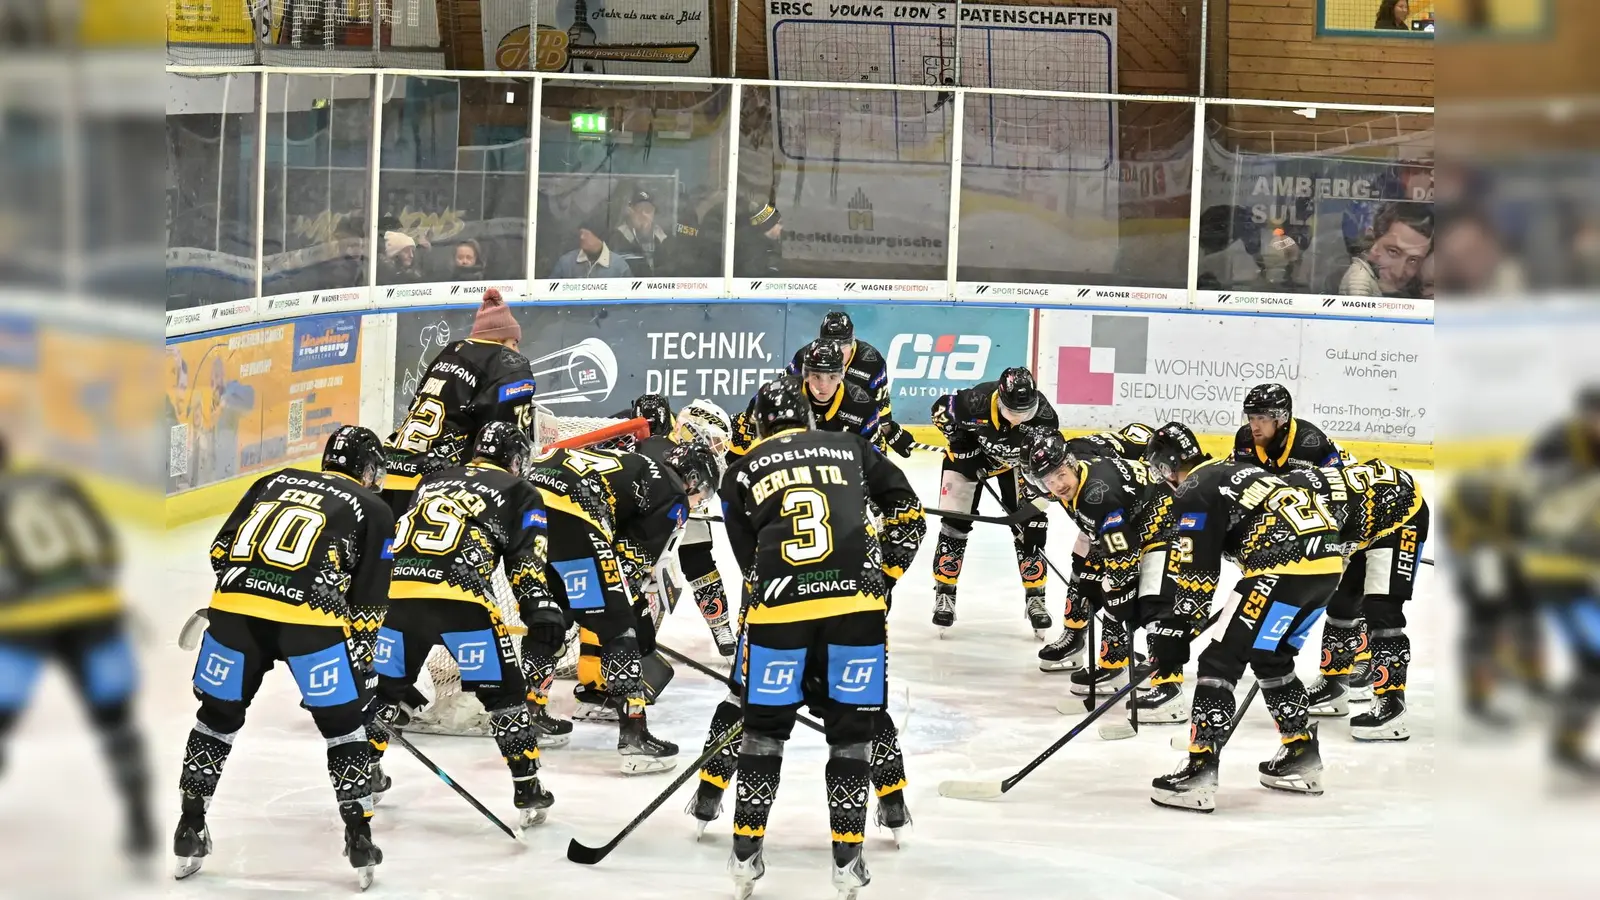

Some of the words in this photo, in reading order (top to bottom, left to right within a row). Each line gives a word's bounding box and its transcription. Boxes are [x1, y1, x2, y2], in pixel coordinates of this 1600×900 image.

[592, 9, 621, 20] Mehr
[624, 9, 637, 20] als
[676, 11, 701, 25] Bild
[771, 2, 813, 16] ERSC
[829, 5, 884, 18] YOUNG
[960, 8, 1113, 26] PATENSCHAFTEN
[571, 48, 689, 61] www.powerpublishing.de
[463, 286, 487, 294] WAGNER
[562, 283, 580, 291] SPORT
[581, 283, 608, 291] SIGNAGE
[676, 282, 708, 290] SPEDITION
[894, 284, 929, 292] SPEDITION
[1017, 288, 1049, 296] SIGNAGE
[1096, 291, 1130, 299] WAGNER
[1131, 292, 1168, 300] SPEDITION
[1234, 296, 1259, 304] SPORT
[1260, 297, 1293, 305] SIGNAGE
[1341, 300, 1377, 309] WAGNER
[1377, 302, 1415, 310] SPEDITION
[647, 332, 772, 362] TECHNIK,
[1326, 349, 1347, 361] Gut
[1348, 350, 1378, 362] und
[1381, 350, 1419, 363] sicher
[1345, 365, 1397, 379] Wohnen
[646, 369, 687, 396] DIE
[899, 387, 963, 397] AUTOMA
[1154, 408, 1243, 427] WERKVOL
[1313, 403, 1415, 419] Hans-Thoma-Str.
[1418, 407, 1426, 418] 9
[1322, 420, 1361, 432] 92224
[1364, 421, 1416, 436] Amberg
[386, 462, 418, 473] GNAGE
[749, 447, 854, 473] GODELMANN
[529, 473, 569, 493] SIGNAGE
[751, 465, 813, 506] BERLIN
[276, 474, 365, 522] GODELMANN
[278, 489, 324, 511] ECKL
[780, 487, 833, 567] 3
[229, 501, 326, 571] 10
[1104, 532, 1128, 554] 19
[397, 558, 432, 567] SPORT
[589, 532, 624, 593] JER53Y
[249, 568, 292, 585] SPORT
[393, 567, 444, 580] SIGNAGE
[796, 569, 841, 584] SPORT
[245, 579, 304, 601] SIGNAGE
[564, 576, 587, 592] LH
[797, 580, 857, 595] SIGNAGE
[490, 611, 516, 664] JER53
[1154, 626, 1184, 637] UER
[459, 650, 485, 664] LH
[205, 653, 229, 682] LH
[842, 666, 873, 684] LH
[310, 666, 339, 688] LH
[763, 667, 795, 686] LH
